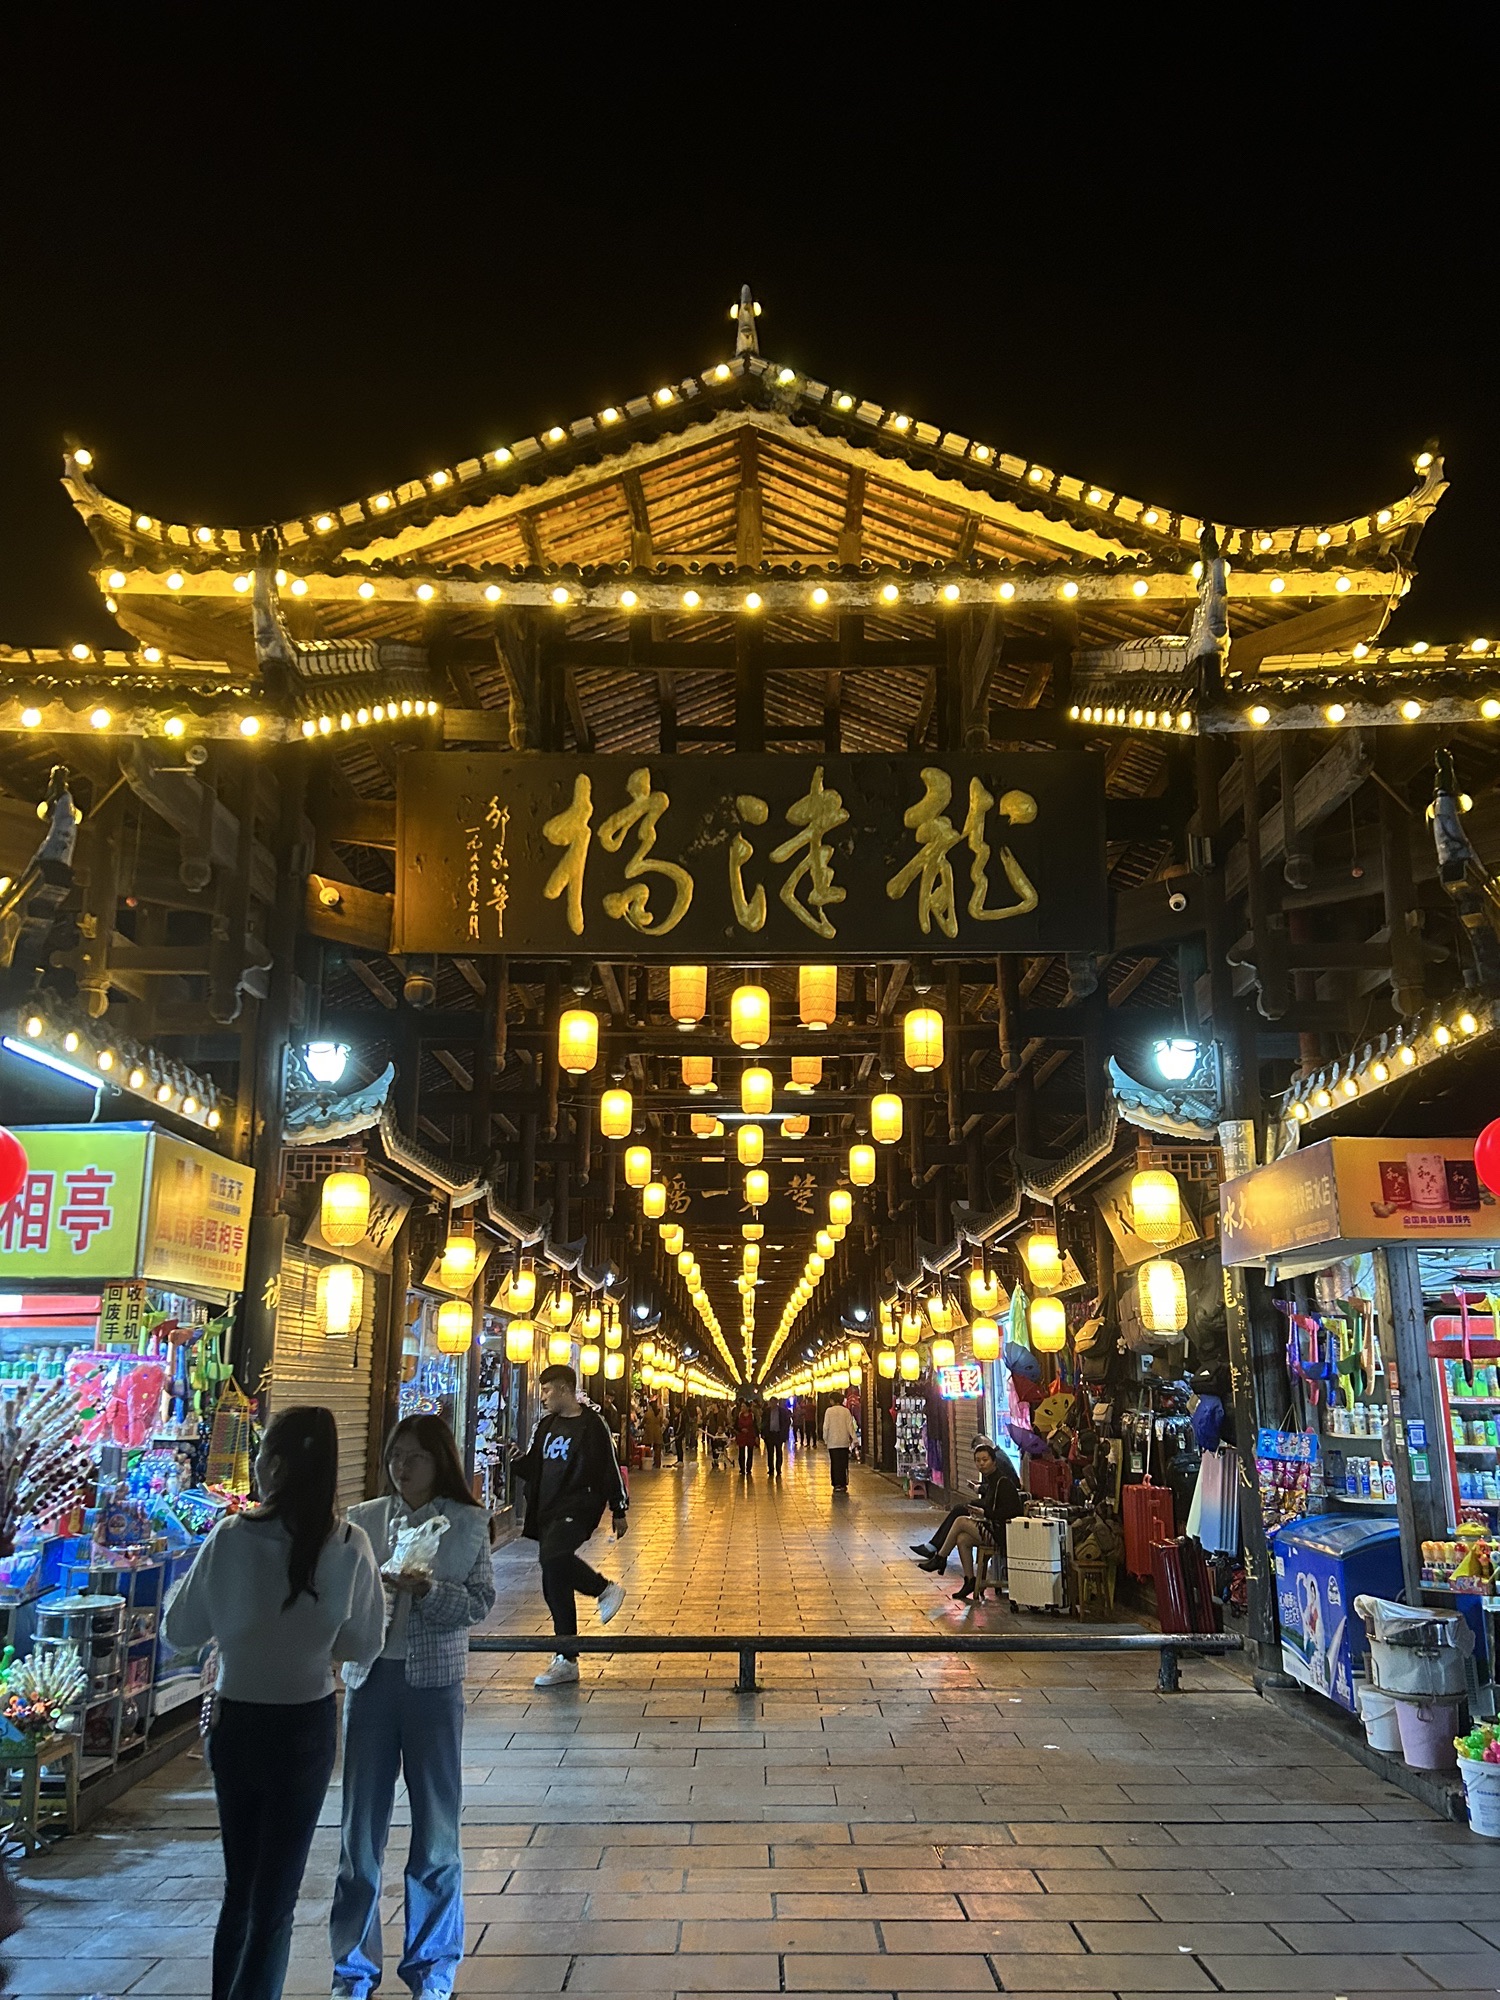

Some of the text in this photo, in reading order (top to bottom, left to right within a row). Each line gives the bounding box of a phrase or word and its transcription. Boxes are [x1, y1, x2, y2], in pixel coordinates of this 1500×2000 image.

[108, 1285, 142, 1301] 回收
[105, 1303, 140, 1320] 废旧
[104, 1323, 139, 1340] 手机
[943, 1368, 980, 1393] 福彩
